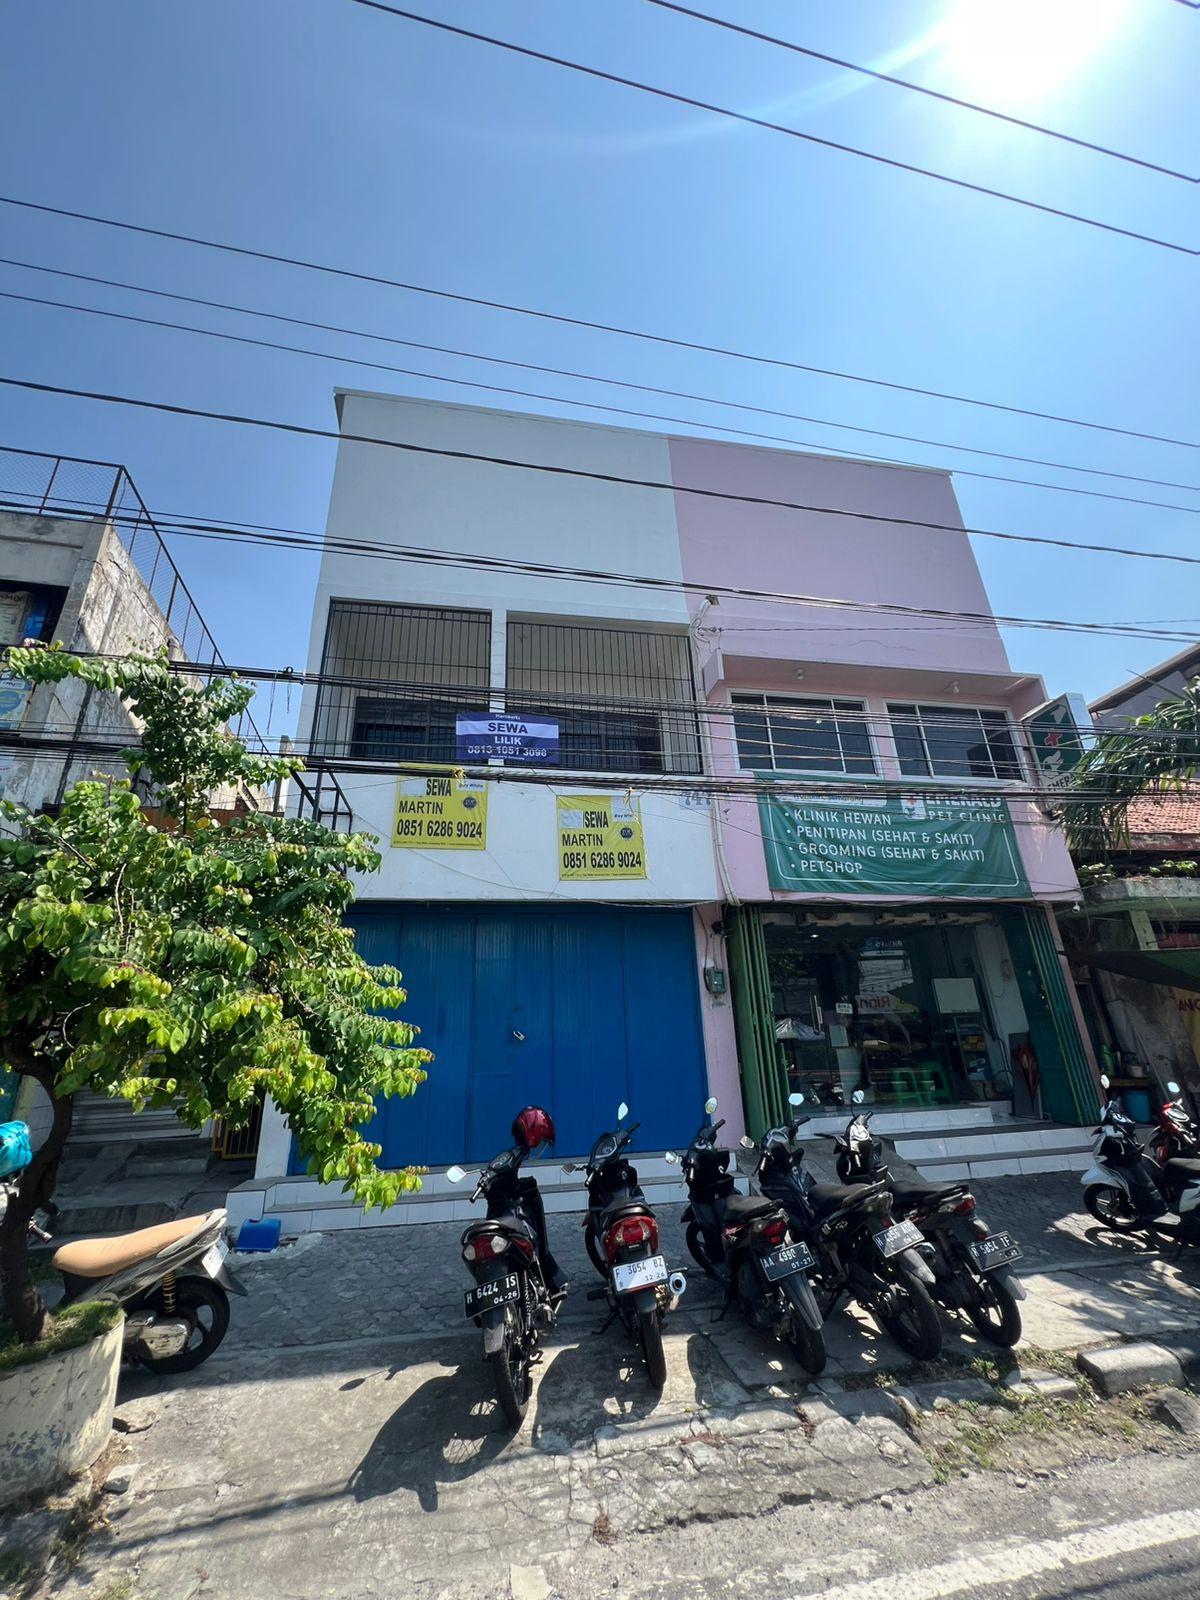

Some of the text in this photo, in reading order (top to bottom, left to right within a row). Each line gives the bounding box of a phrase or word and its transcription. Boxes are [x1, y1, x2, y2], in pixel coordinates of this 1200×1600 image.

[487, 722, 528, 734] SEWA
[494, 735, 522, 745] LILIK
[467, 745, 493, 755] 0813
[496, 745, 519, 756] 1051
[426, 778, 452, 797] SEWA
[398, 800, 443, 815] MARTIN
[794, 809, 892, 826] KLINIK HEWAN
[928, 809, 1007, 824] PET CLINIC
[396, 818, 483, 839] 0851 6286 9024
[796, 825, 975, 847] PENITIPAN (SEHAT & SAKIT)
[562, 833, 603, 847] MARTIN
[563, 851, 642, 869] 0851 6286 9024
[798, 841, 985, 863] GROOMING (SEHAT & SAKIT)
[800, 858, 863, 875] PETSHOP
[762, 1256, 776, 1270] AA
[800, 1243, 809, 1255] Z
[614, 1257, 664, 1279] F 3054 BZ
[466, 1292, 473, 1305] H
[476, 1281, 499, 1300] 6424
